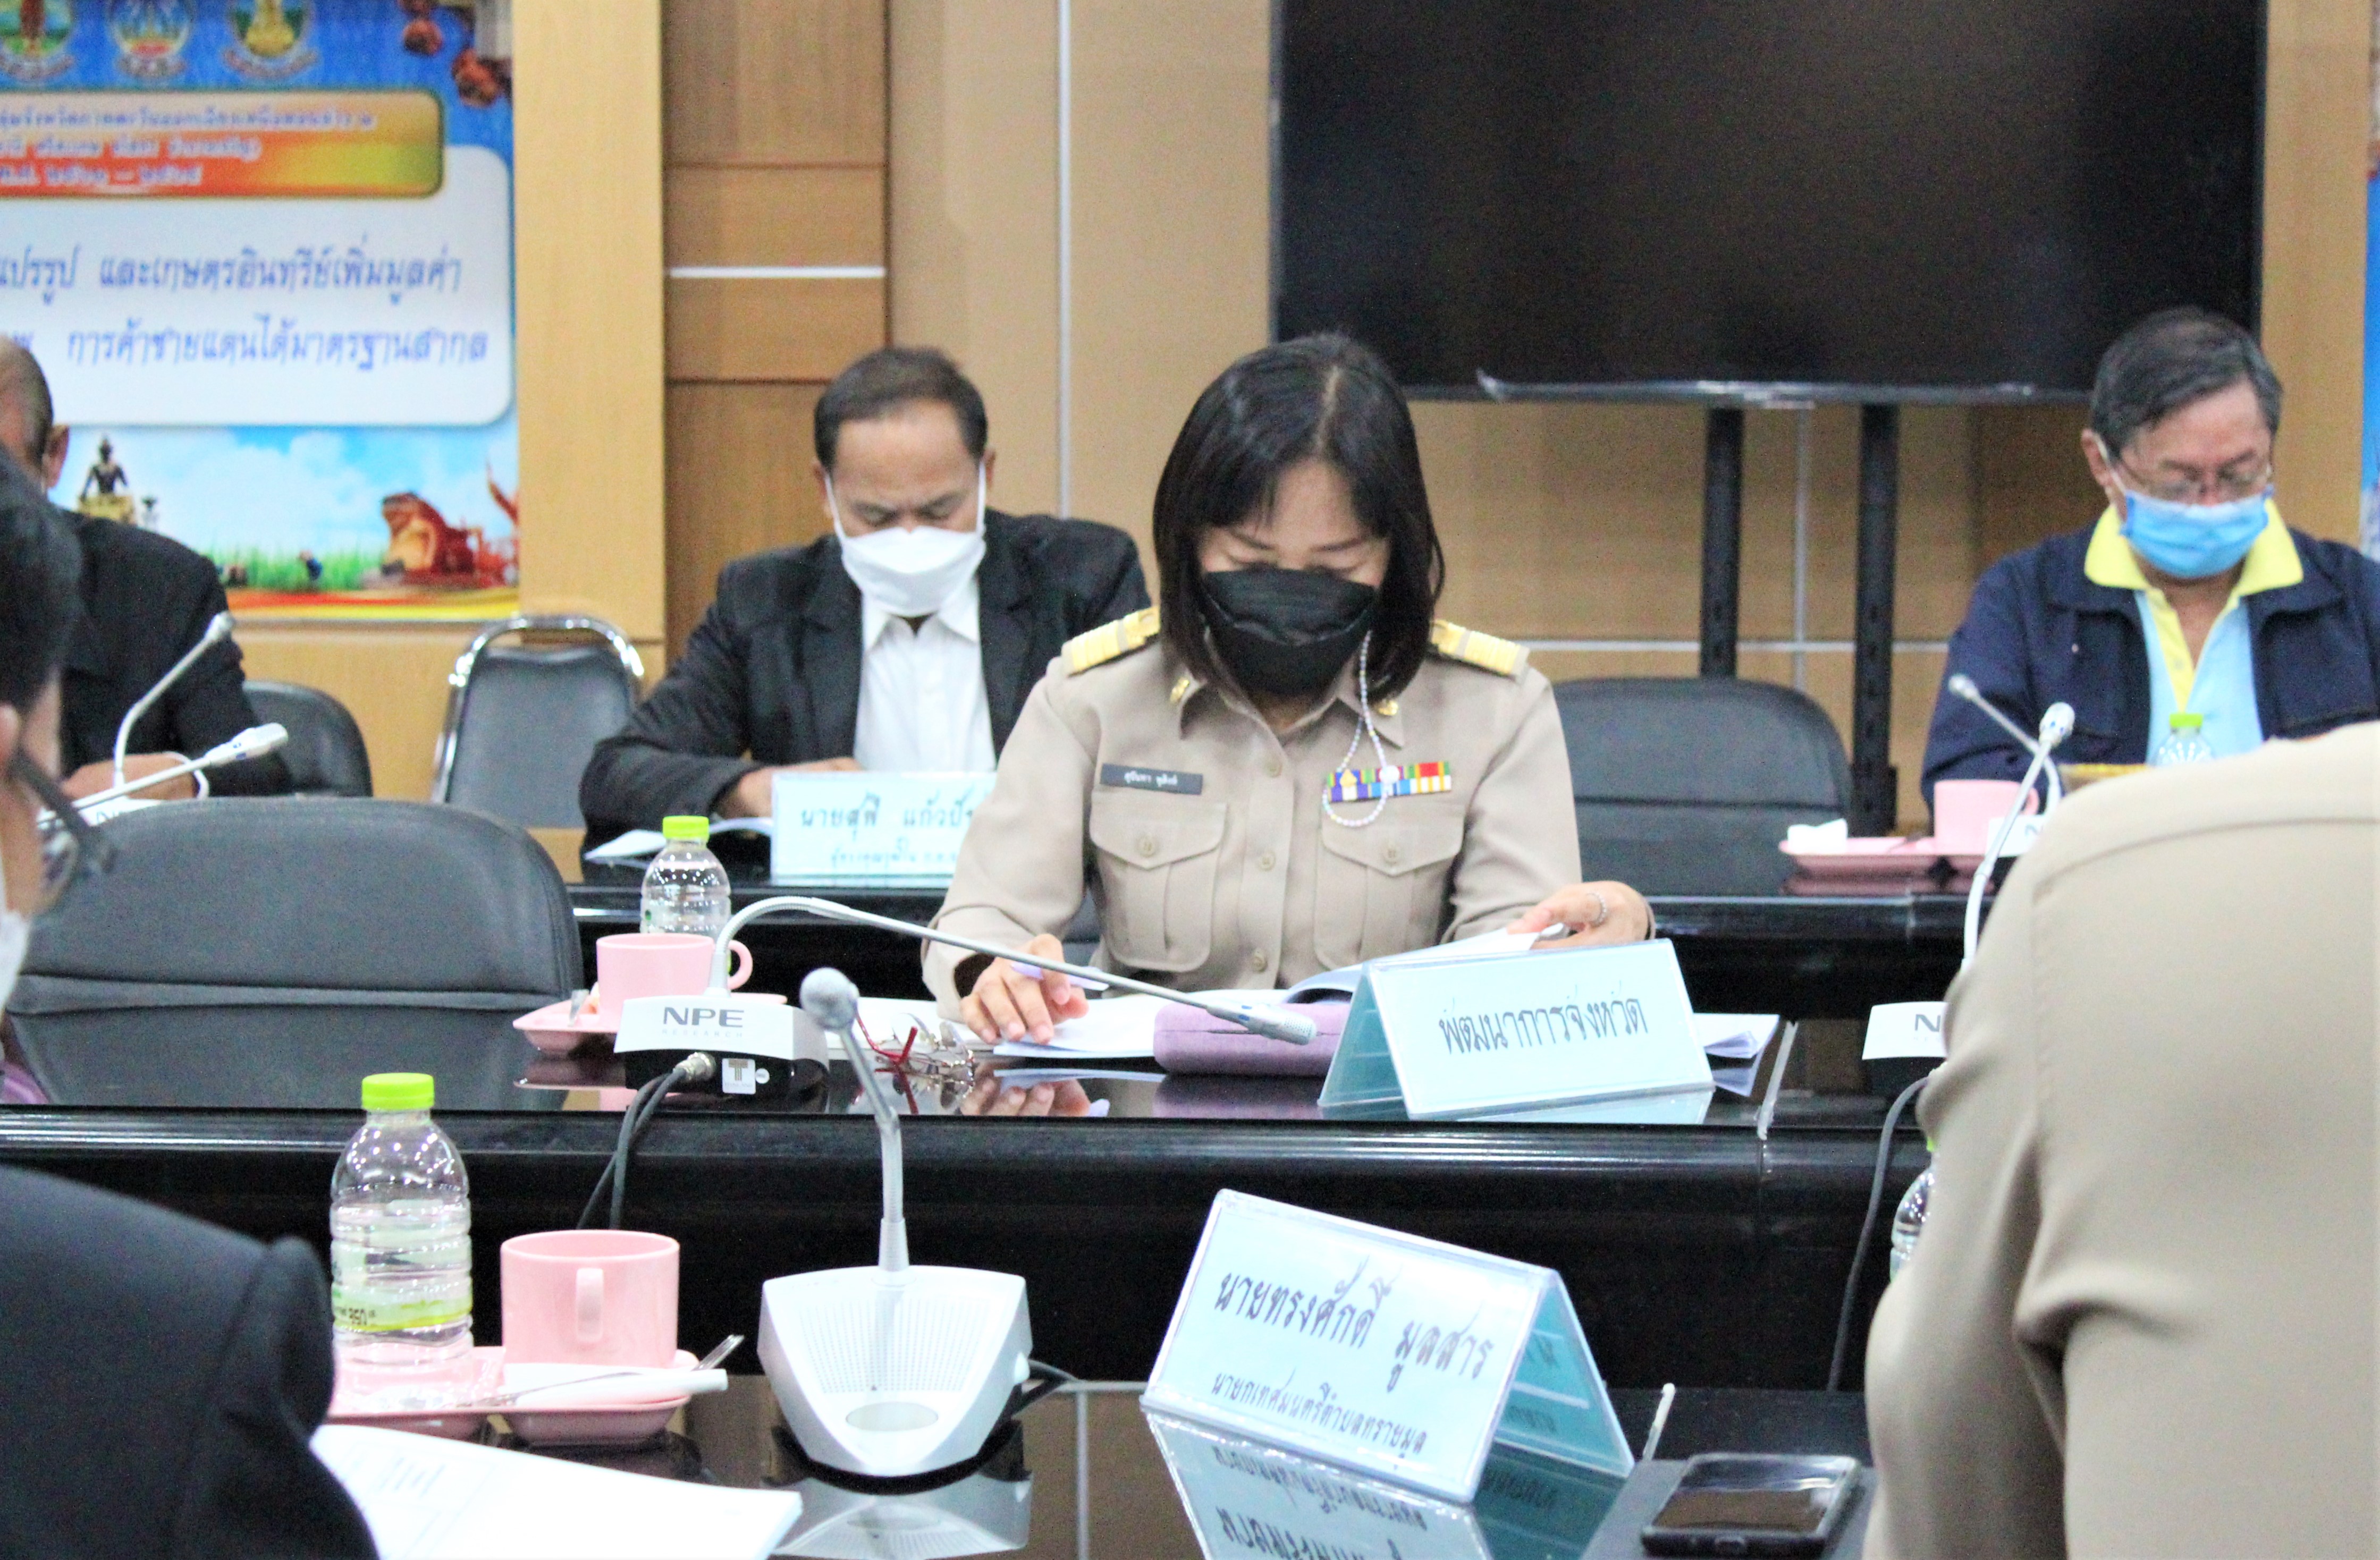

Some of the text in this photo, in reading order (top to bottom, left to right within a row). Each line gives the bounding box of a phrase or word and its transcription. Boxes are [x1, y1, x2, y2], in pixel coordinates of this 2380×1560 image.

[663, 1007, 744, 1028] NPE
[1439, 980, 1648, 1055] พัฒนาการจังหวัด
